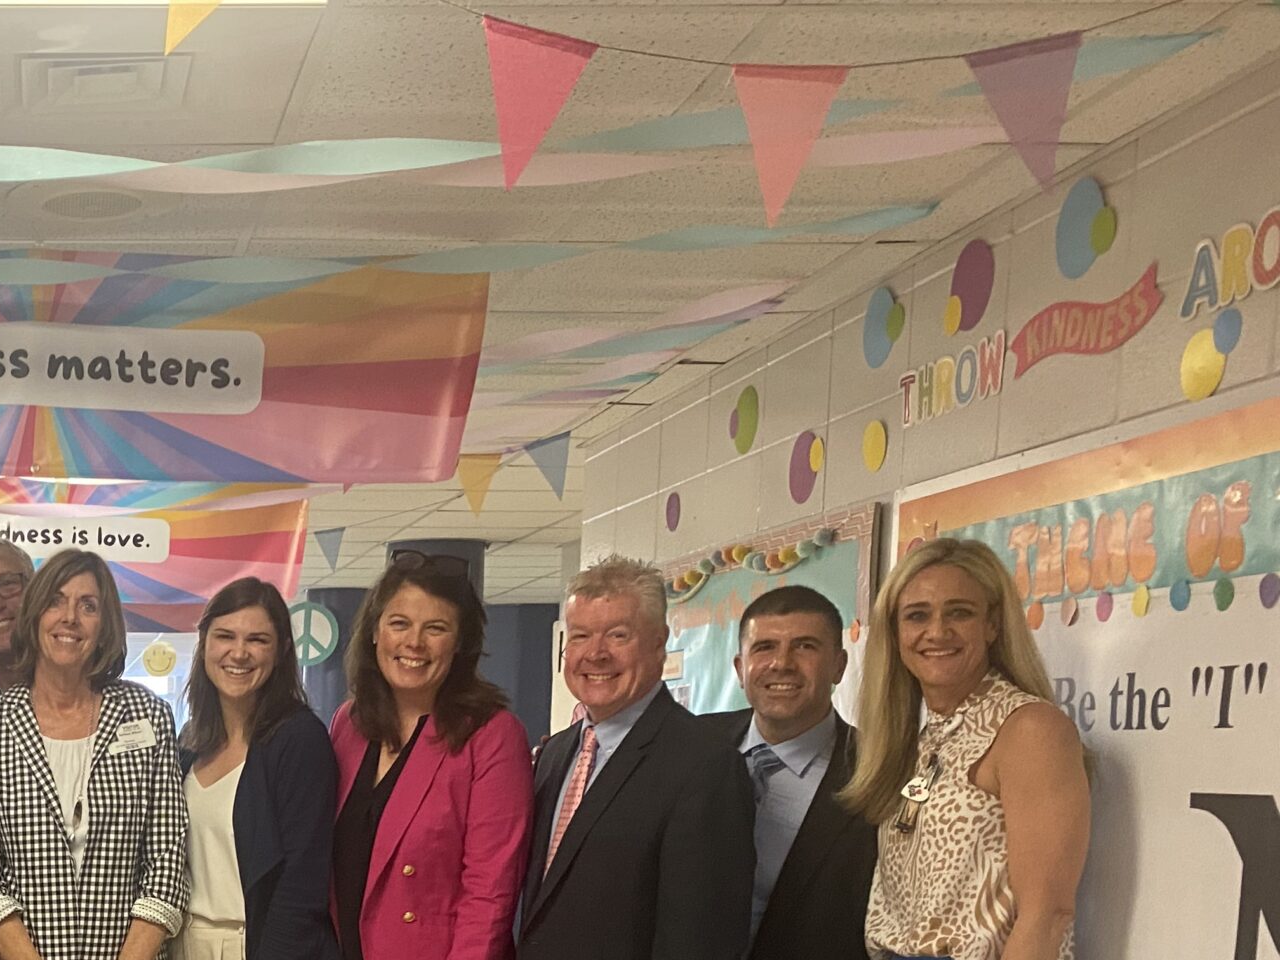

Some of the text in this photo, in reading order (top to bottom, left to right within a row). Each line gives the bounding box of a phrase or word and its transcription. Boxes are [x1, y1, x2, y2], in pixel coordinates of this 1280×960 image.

[47, 350, 242, 388] matters.
[900, 283, 1150, 428] THROW KINDNESS
[71, 526, 89, 546] is
[97, 527, 151, 548] love.
[1053, 661, 1269, 732] Be the "I"
